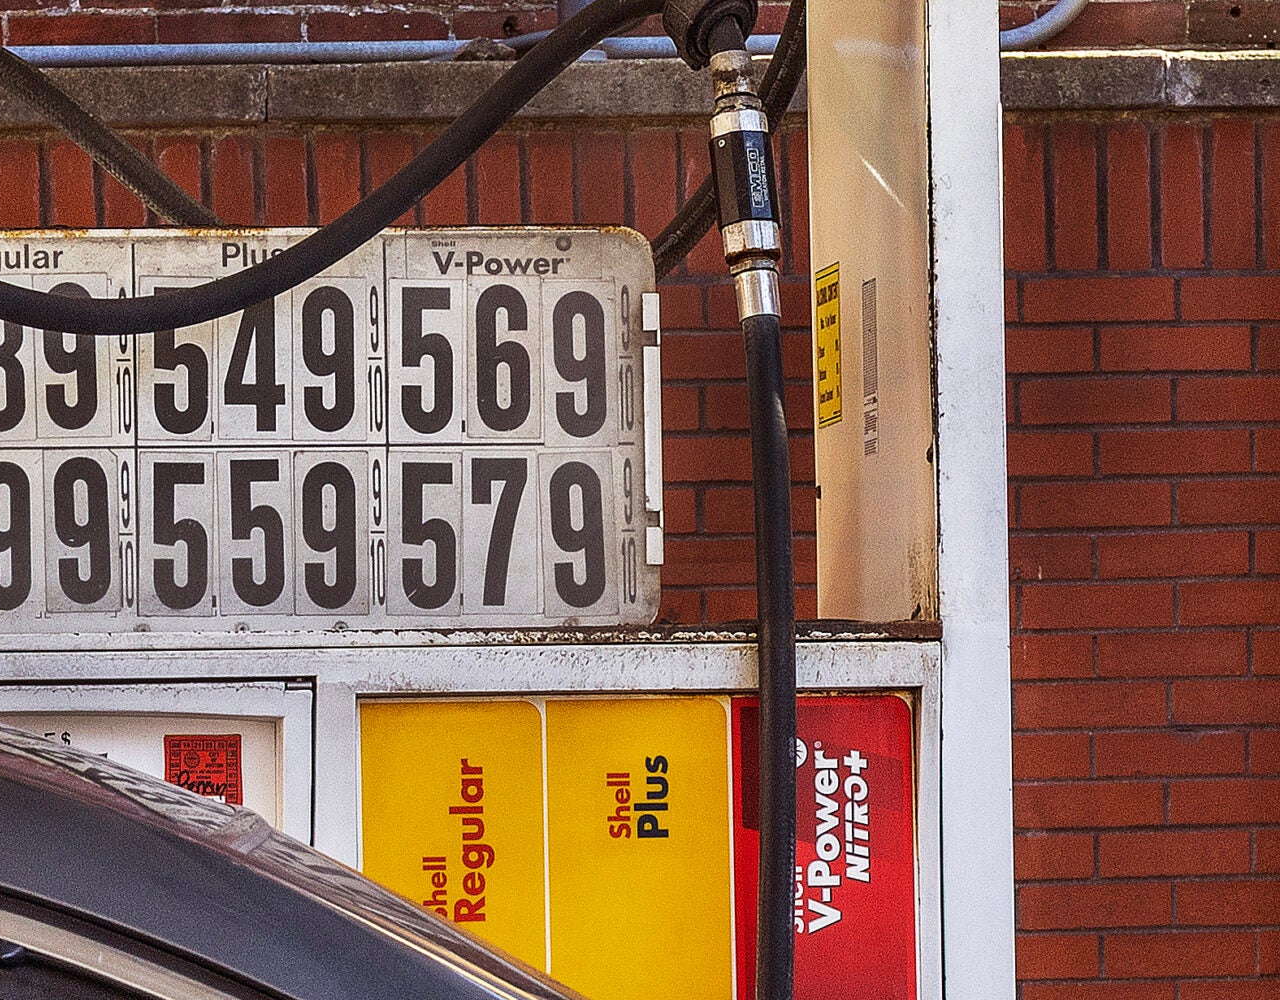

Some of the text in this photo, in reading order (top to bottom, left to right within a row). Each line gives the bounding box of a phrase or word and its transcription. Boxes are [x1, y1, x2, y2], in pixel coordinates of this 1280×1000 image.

[432, 251, 564, 275] V-Power
[606, 772, 631, 838] Shell
[634, 755, 669, 838] Plus
[449, 758, 495, 923] Regular
[807, 749, 842, 934] V-Power
